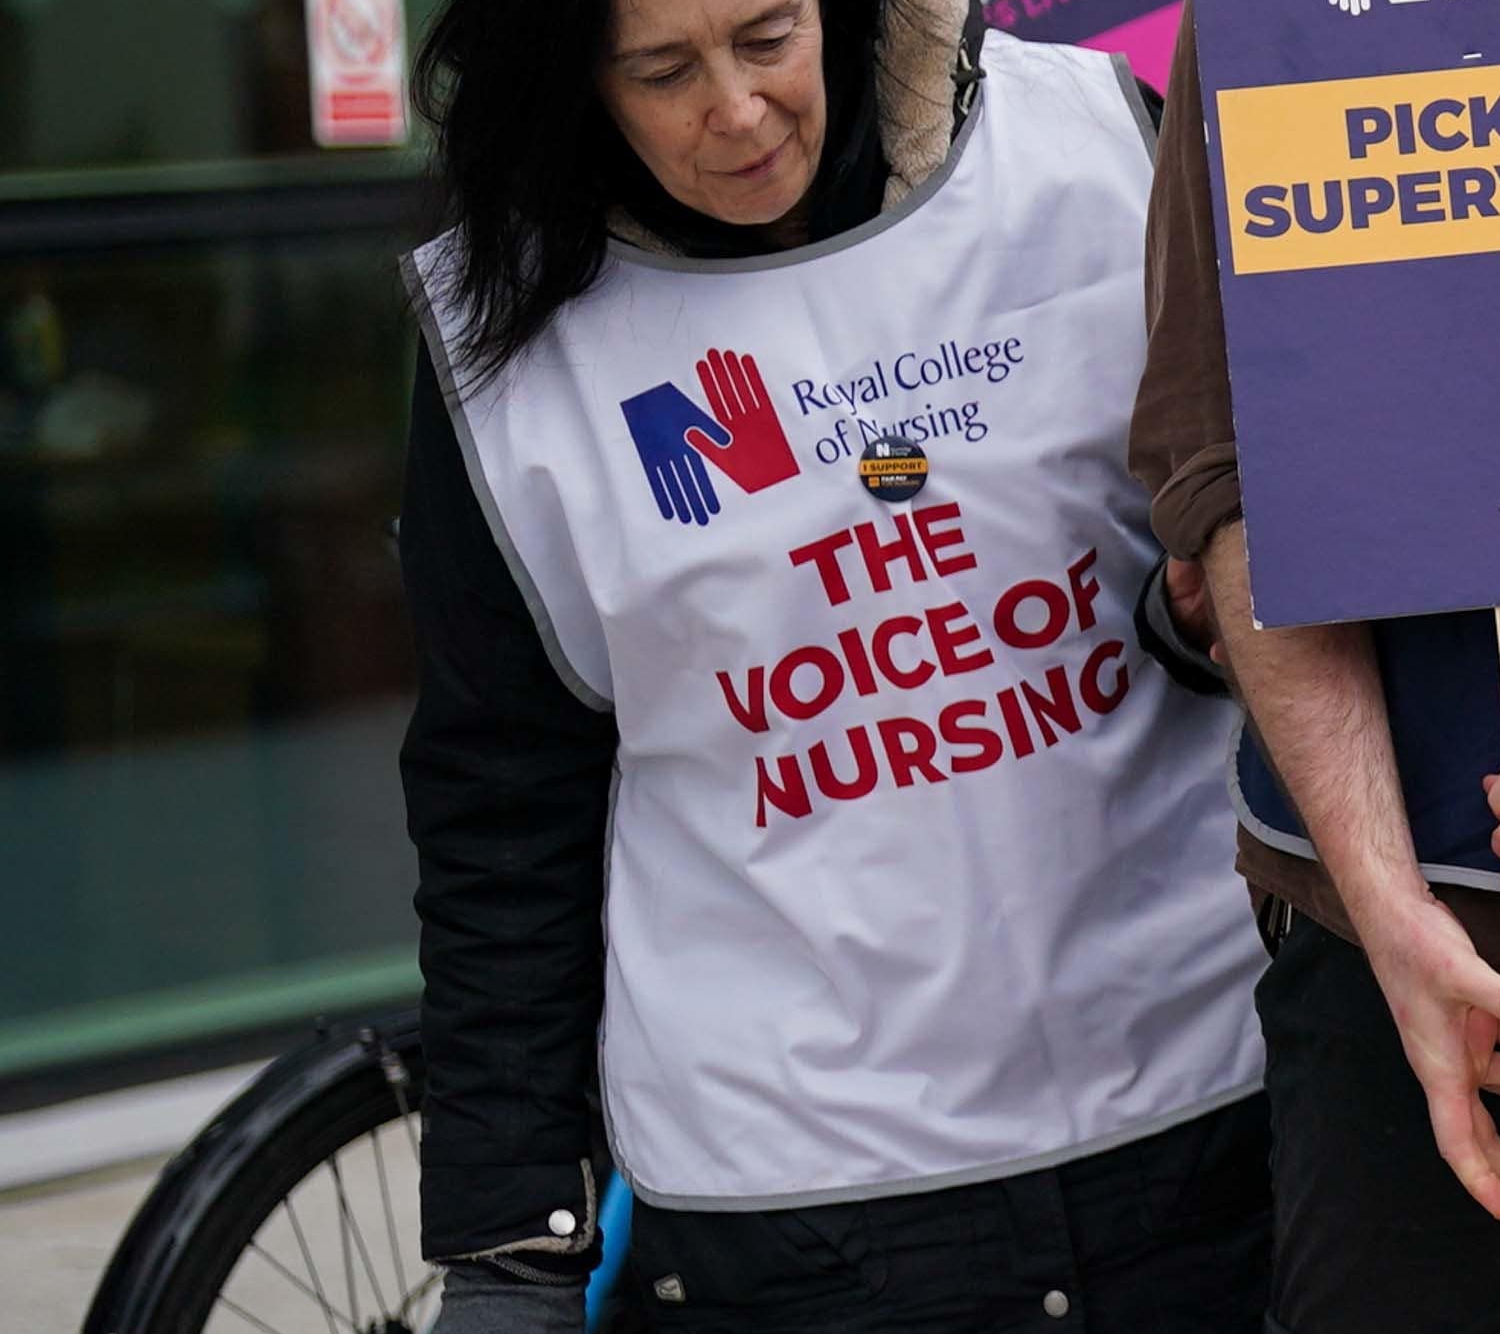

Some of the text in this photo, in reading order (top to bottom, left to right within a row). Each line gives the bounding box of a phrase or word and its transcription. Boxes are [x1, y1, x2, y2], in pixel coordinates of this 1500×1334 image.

[792, 334, 1025, 417] Royal College
[814, 420, 850, 466] of
[788, 501, 978, 607] THE
[716, 546, 1102, 734] VOICE OF
[754, 639, 1132, 829] NURSING
